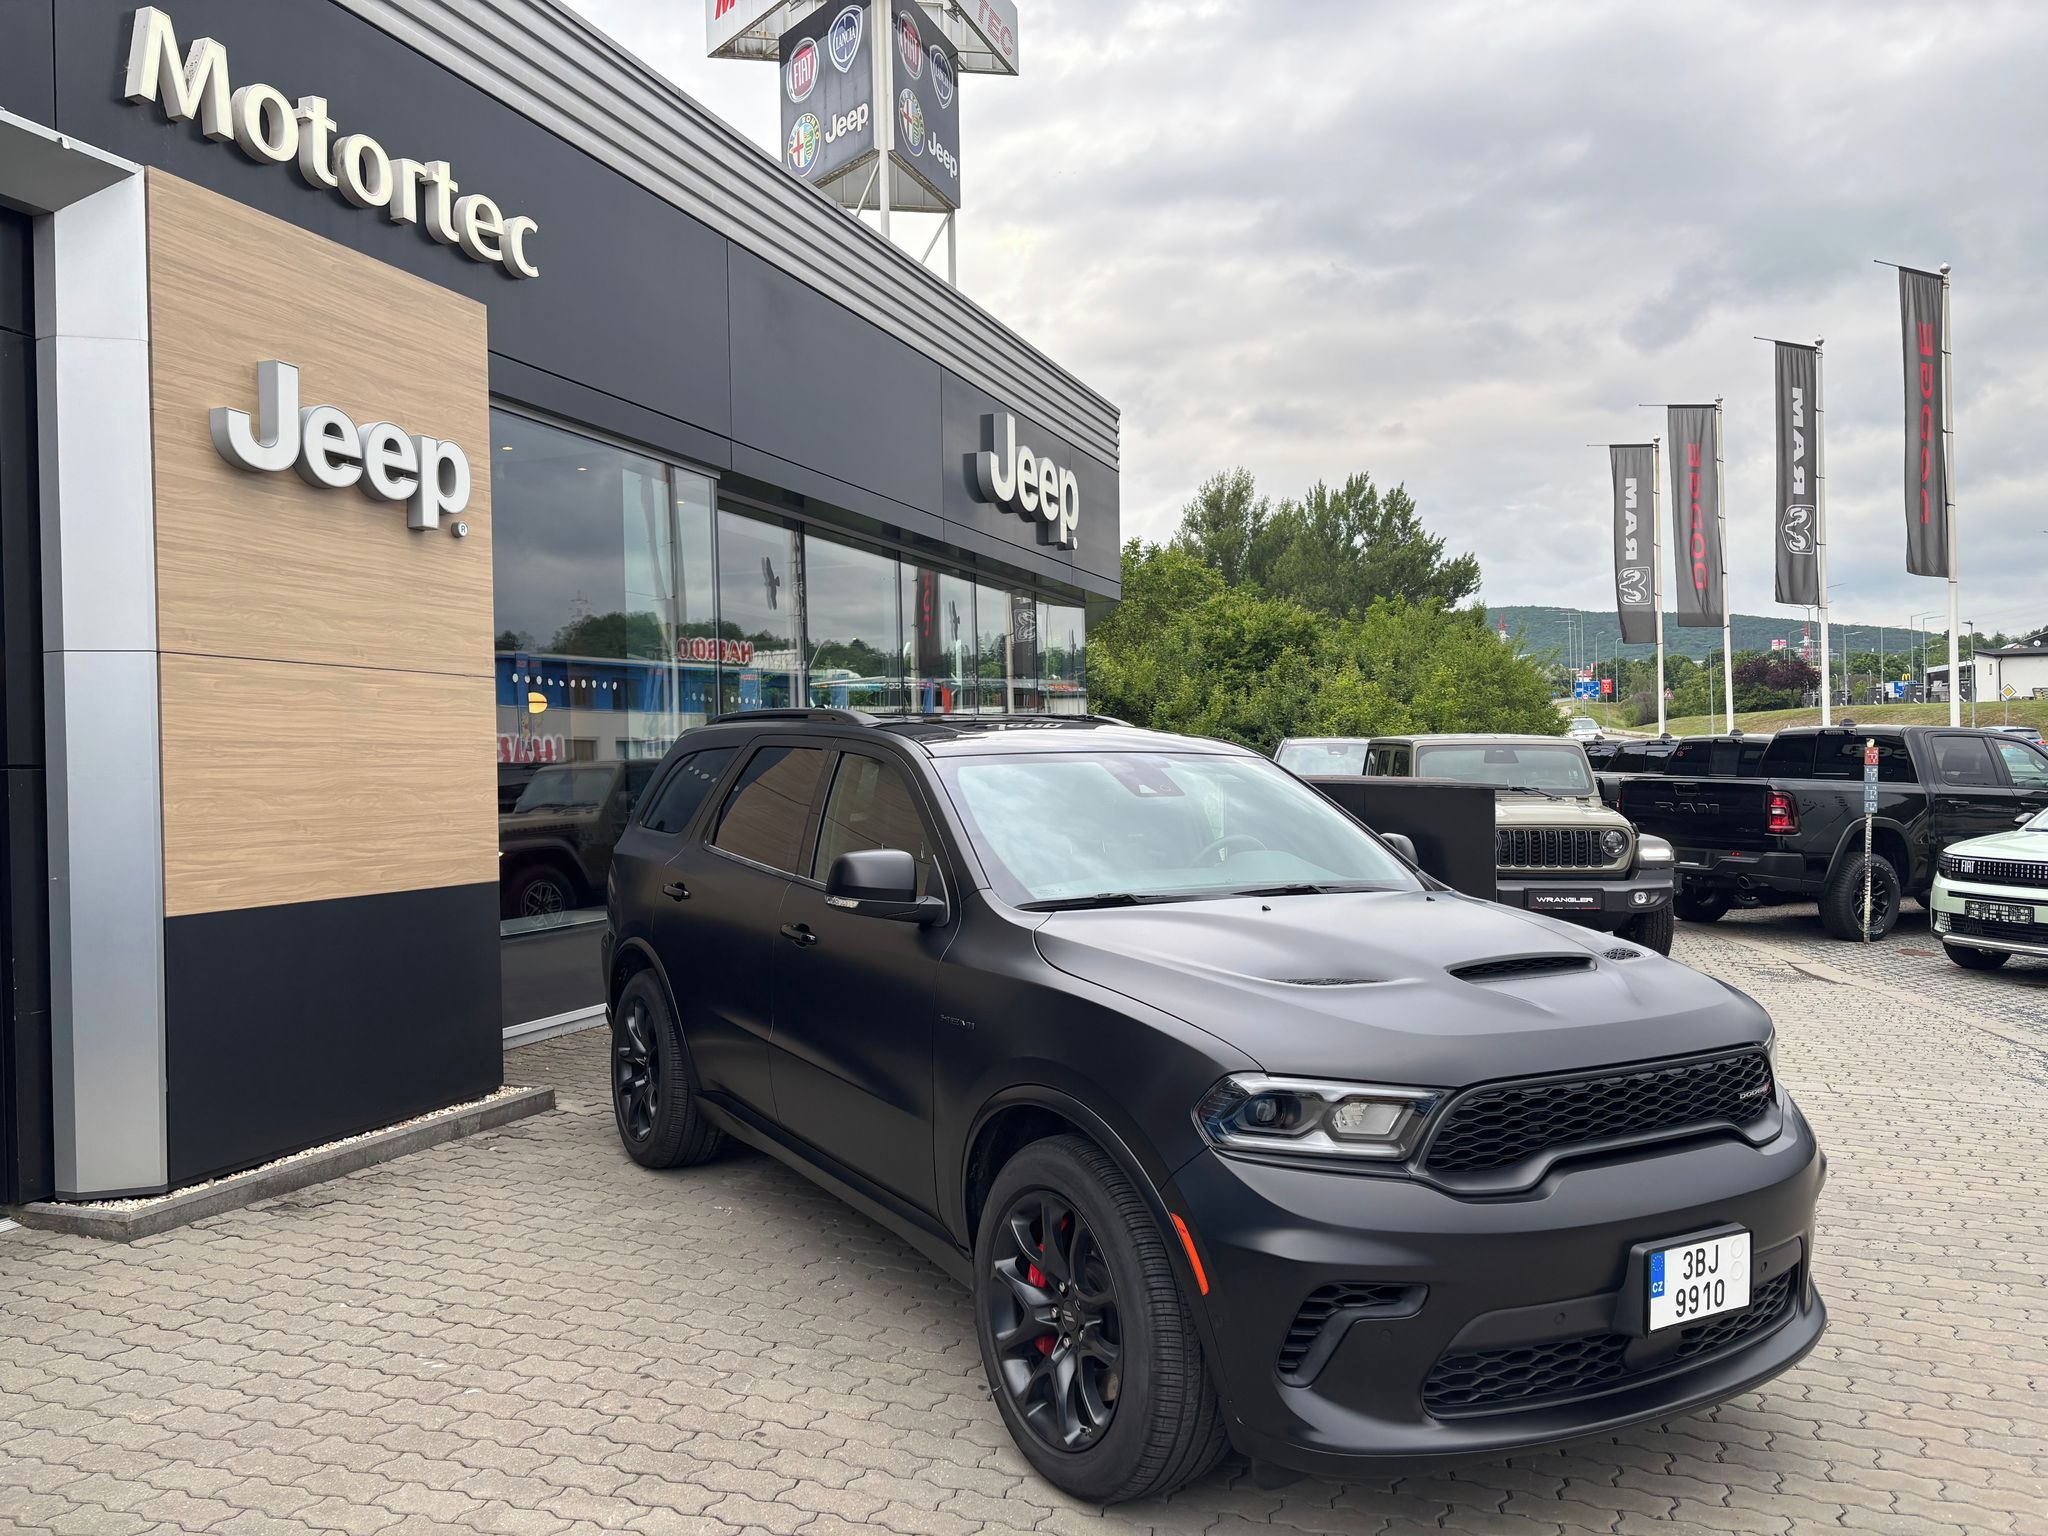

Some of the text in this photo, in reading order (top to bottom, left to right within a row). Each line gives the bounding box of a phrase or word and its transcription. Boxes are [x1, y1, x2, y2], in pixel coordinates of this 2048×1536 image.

[793, 53, 812, 90] FIAT
[125, 6, 540, 280] Motortec
[825, 103, 869, 144] Jeep
[928, 131, 957, 179] Jeep
[210, 360, 470, 532] Jeep
[977, 412, 1079, 545] Jeep
[1655, 801, 1720, 814] RAM
[1961, 860, 1975, 874] FIAT
[1683, 1244, 1719, 1280] 3BJ
[1652, 1281, 1663, 1293] CZ
[1676, 1279, 1725, 1318] 9910
